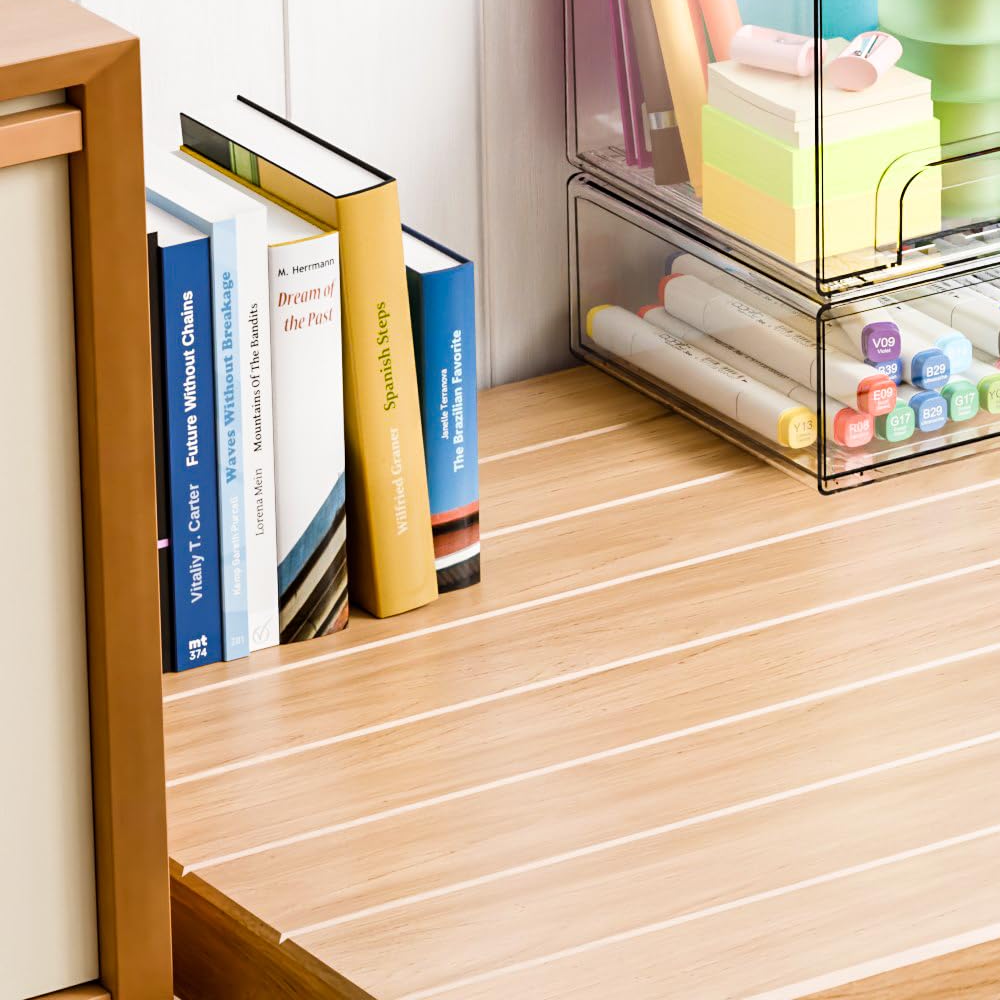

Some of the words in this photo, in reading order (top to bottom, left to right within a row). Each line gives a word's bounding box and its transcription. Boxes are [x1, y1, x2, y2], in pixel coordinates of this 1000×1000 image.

[277, 268, 289, 277] M.
[292, 258, 335, 275] Herrmann
[277, 287, 321, 308] Dream
[323, 280, 336, 299] of
[180, 290, 195, 347] Chains
[220, 271, 234, 353] Breakage
[248, 303, 259, 348] Bandits
[284, 314, 306, 333] the
[308, 307, 333, 328] Past
[376, 301, 391, 346] Steps
[450, 329, 462, 384] Favorite
[872, 336, 896, 348] V09
[250, 349, 261, 373] The
[926, 363, 946, 378] B29
[182, 348, 197, 413] Without
[223, 354, 236, 427] Without
[250, 374, 260, 389] Of
[378, 347, 399, 412] Spanish
[439, 368, 448, 408] Terranova
[873, 387, 894, 401] E09
[452, 386, 464, 443] Brazilian
[922, 405, 943, 420] B29
[955, 392, 975, 406] G17
[251, 388, 263, 453] Mountains
[440, 409, 449, 440] Janelle
[890, 413, 911, 427] G17
[185, 414, 199, 468] Future
[225, 429, 238, 486] Waves
[453, 446, 465, 473] The
[254, 467, 264, 497] Mein
[188, 483, 201, 532] Carter
[255, 498, 265, 537] Lorena
[391, 479, 409, 536] Wilfried
[188, 535, 201, 553] T.
[190, 555, 205, 604] Vitaliy
[188, 634, 208, 650] mt
[189, 649, 208, 661] 374
